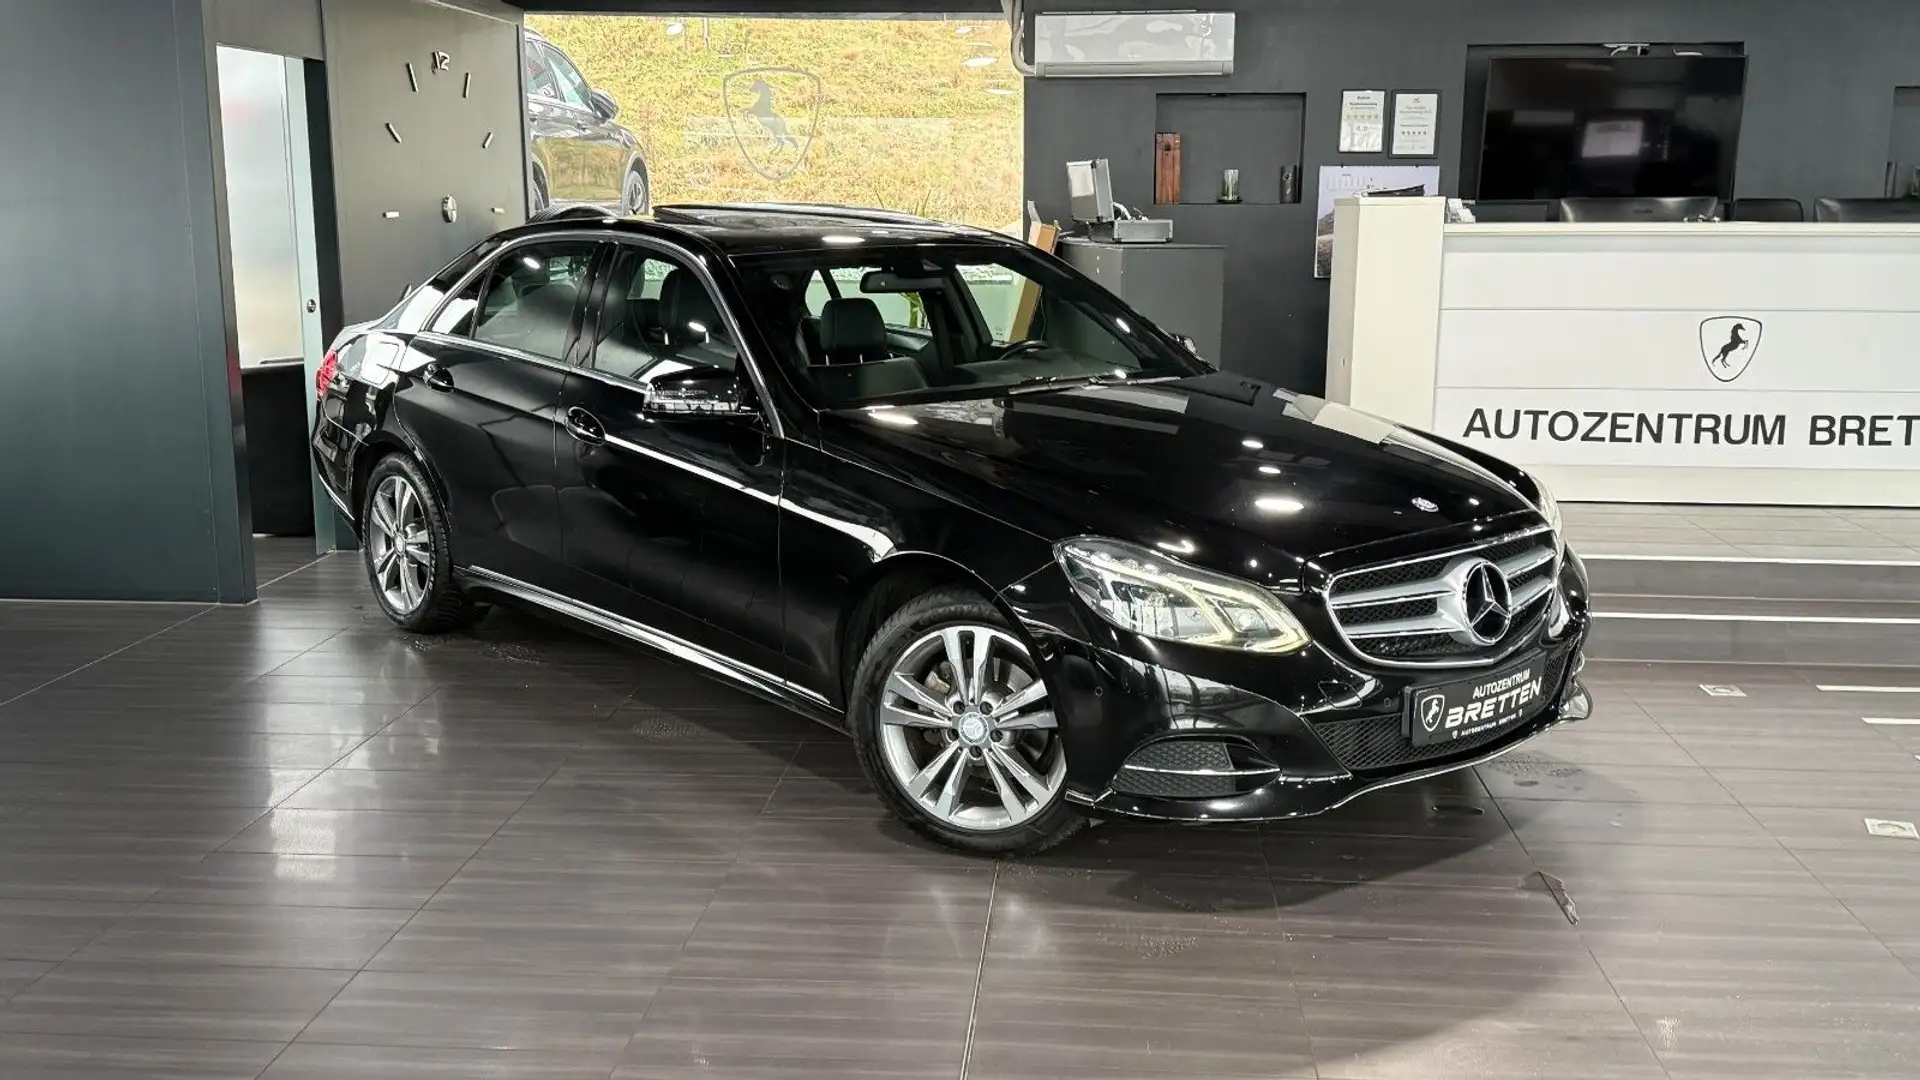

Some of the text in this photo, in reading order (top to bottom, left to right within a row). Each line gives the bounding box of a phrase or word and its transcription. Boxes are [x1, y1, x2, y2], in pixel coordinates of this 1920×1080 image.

[432, 51, 450, 71] 12
[1463, 408, 1920, 446] AUTOZENTRUM BRET
[1473, 669, 1530, 699] AUTOZENTRUM
[1445, 677, 1541, 729] BRETTEN
